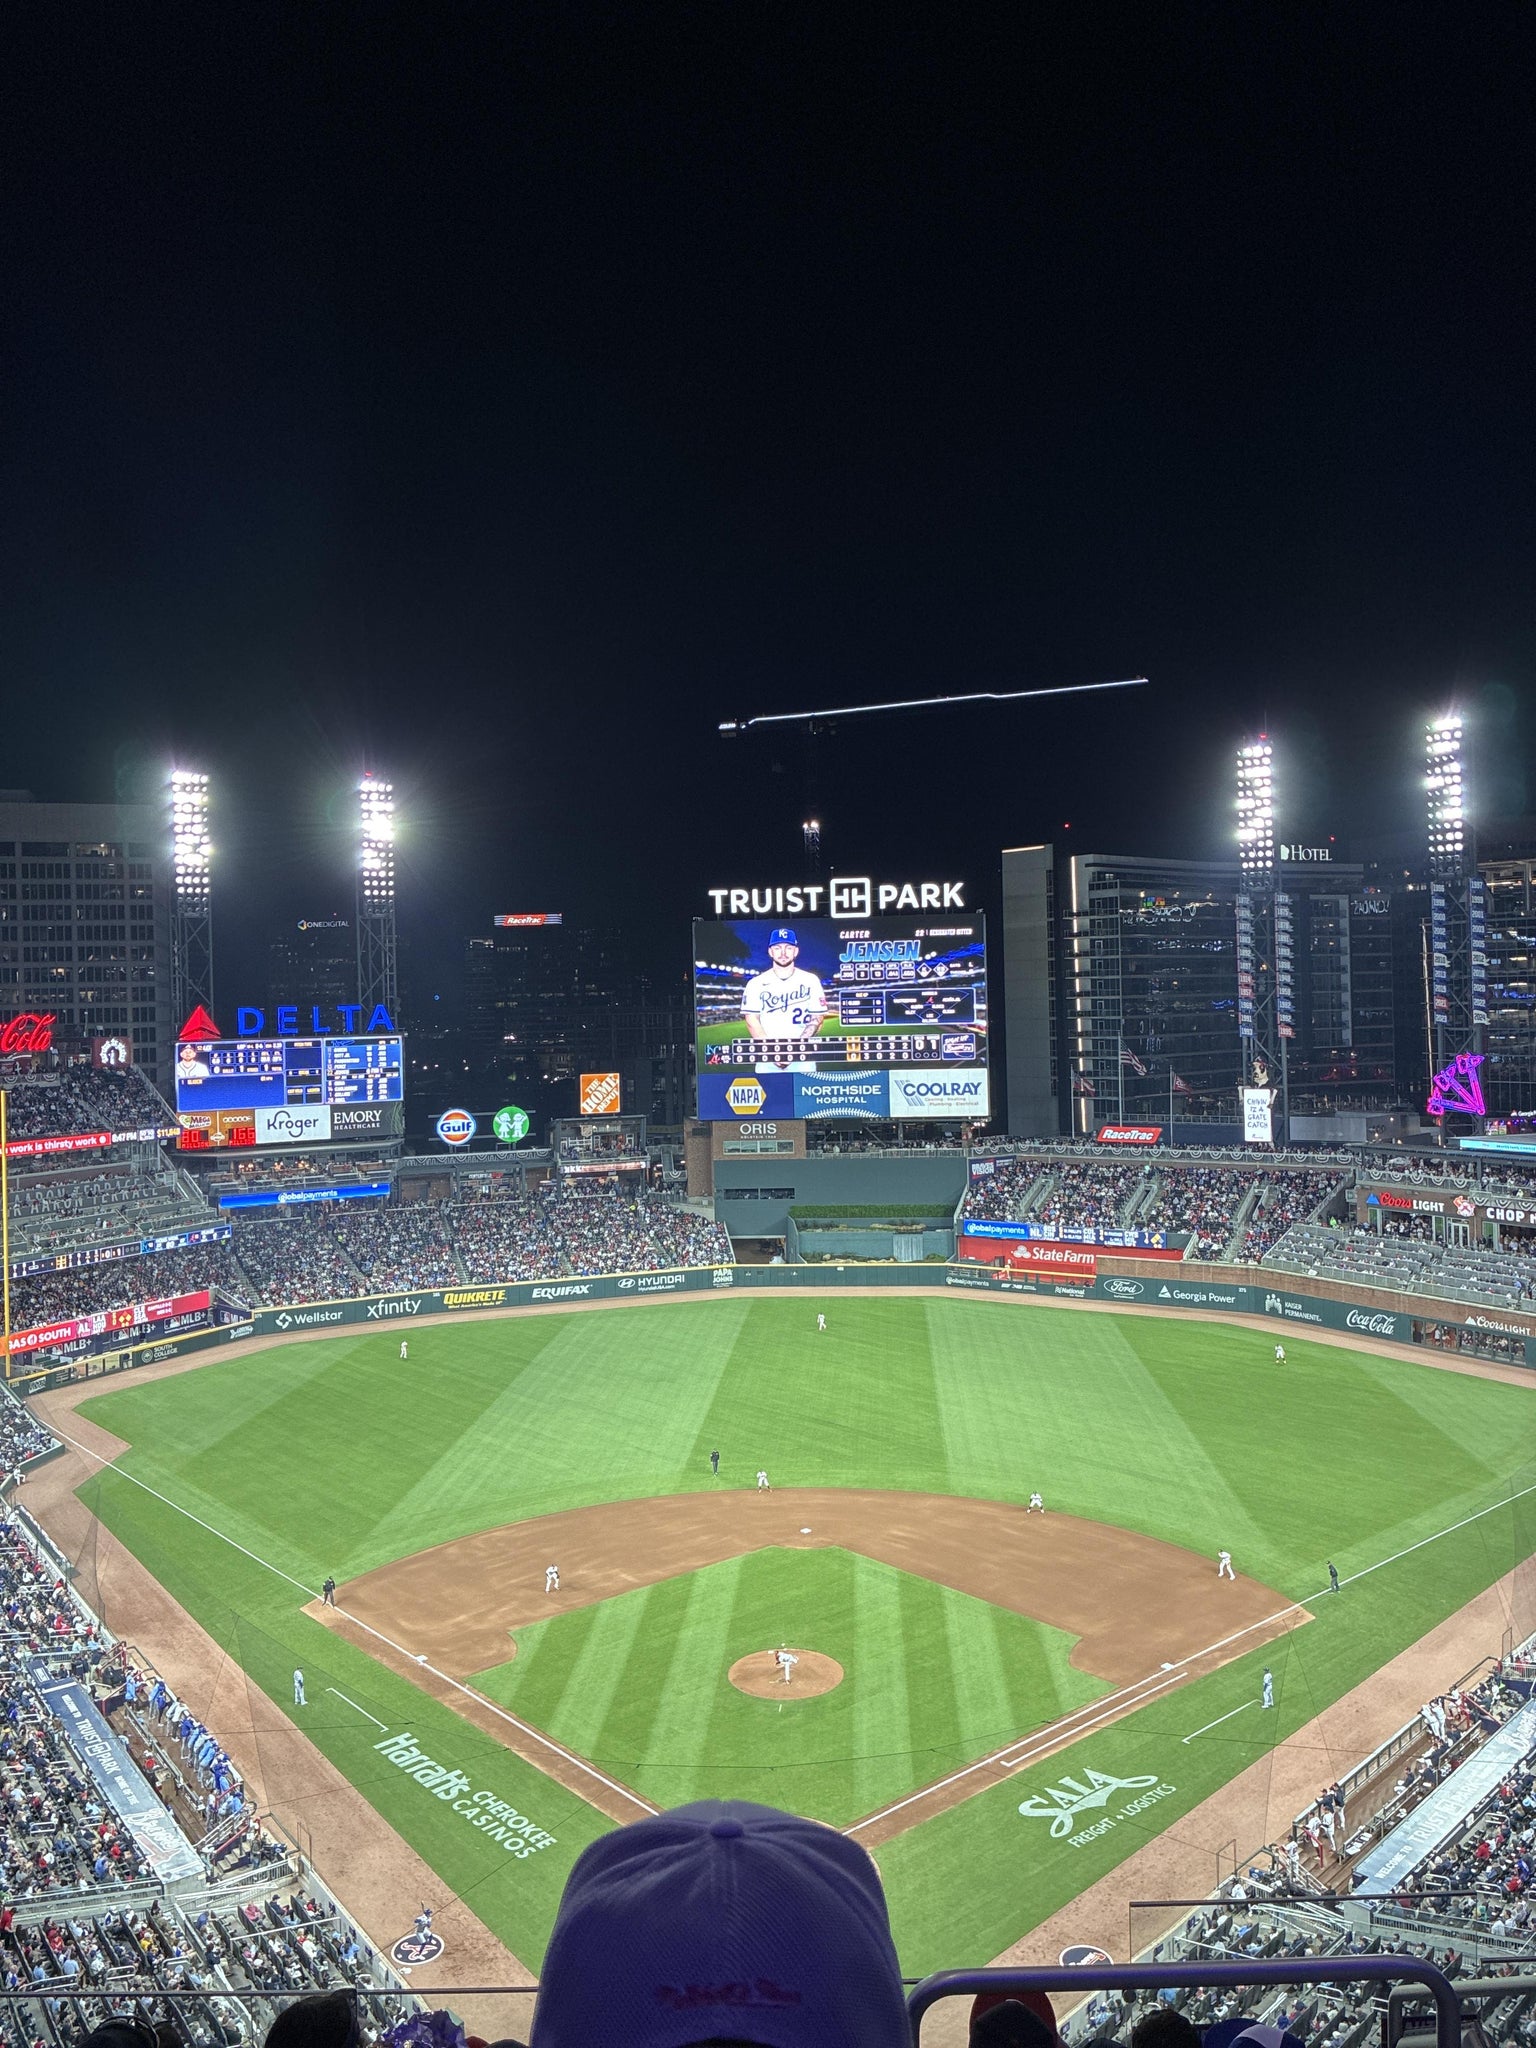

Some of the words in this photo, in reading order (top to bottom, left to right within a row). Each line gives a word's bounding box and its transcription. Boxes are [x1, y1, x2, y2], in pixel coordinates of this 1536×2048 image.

[1291, 845, 1332, 860] HOTEL
[708, 887, 823, 914] TRUIST
[879, 882, 964, 909] PARK
[307, 919, 349, 929] ONEDIGITAL
[840, 930, 870, 939] CARTER
[839, 940, 920, 962] JENSEN
[760, 984, 811, 1013] Royals
[238, 1004, 395, 1035] DELTA
[915, 1040, 924, 1050] 0
[931, 1040, 936, 1049] 1
[582, 1074, 620, 1112] HOME
[585, 1079, 601, 1094] THE
[801, 1085, 881, 1096] NORTHSIDE
[903, 1082, 982, 1097] COOLRAY
[596, 1088, 619, 1112] DEPOT
[730, 1088, 760, 1105] NAPA
[267, 1110, 319, 1138] Kroger
[334, 1110, 382, 1124] EMORY
[234, 1128, 255, 1139] 166
[440, 1122, 472, 1132] Gulf
[740, 1123, 777, 1134] ORIS
[1103, 1130, 1153, 1140] RaceTrac
[10, 1142, 33, 1154] work
[35, 1140, 42, 1151] is
[44, 1137, 73, 1151] thirsty
[75, 1136, 97, 1146] work
[31, 1197, 83, 1213] AARON
[93, 1188, 158, 1204] TERRACE
[278, 1190, 337, 1202] globalpayments
[1380, 1192, 1412, 1208] Coors
[1413, 1200, 1444, 1212] LIGHT
[1487, 1208, 1525, 1222] CHOP
[967, 1223, 1025, 1235] globalpayments
[1030, 1228, 1042, 1237] NL
[713, 1268, 732, 1276] PAPA
[638, 1274, 685, 1286] HYUNDAI
[946, 1277, 989, 1286] globalpayments
[1111, 1280, 1137, 1292] Ford
[444, 1290, 506, 1304] QUIKRETE
[532, 1285, 590, 1299] EQUIFAX
[1173, 1290, 1207, 1302] Georgia
[1209, 1292, 1235, 1304] Power
[367, 1298, 421, 1318] xfinity
[1284, 1302, 1302, 1310] KAISER
[180, 1310, 206, 1325] MLB+
[294, 1311, 342, 1324] Wellstar
[1284, 1309, 1322, 1322] PERMANENTE
[1347, 1310, 1397, 1335] Coca-Cola
[77, 1323, 90, 1334] AL
[130, 1324, 156, 1337] MB+
[1476, 1315, 1504, 1331] Coors
[1504, 1325, 1530, 1336] LIGHT
[38, 1327, 70, 1342] SOUTH
[64, 1339, 92, 1353] MLB+
[154, 1344, 172, 1352] SOUTH
[154, 1348, 178, 1358] COLLEGE
[76, 1719, 102, 1747] TRUIST
[98, 1752, 120, 1774] PARK
[1018, 1768, 1158, 1838] SAIA
[472, 1791, 558, 1850] CHEROKEE
[1067, 1818, 1117, 1848] FREIGHT
[1120, 1783, 1177, 1816] LOGISTICS
[452, 1800, 536, 1858] CASINOS
[1408, 1812, 1446, 1844] TRUIST
[1374, 1852, 1406, 1879] WELCOME
[1400, 1846, 1413, 1858] TO
